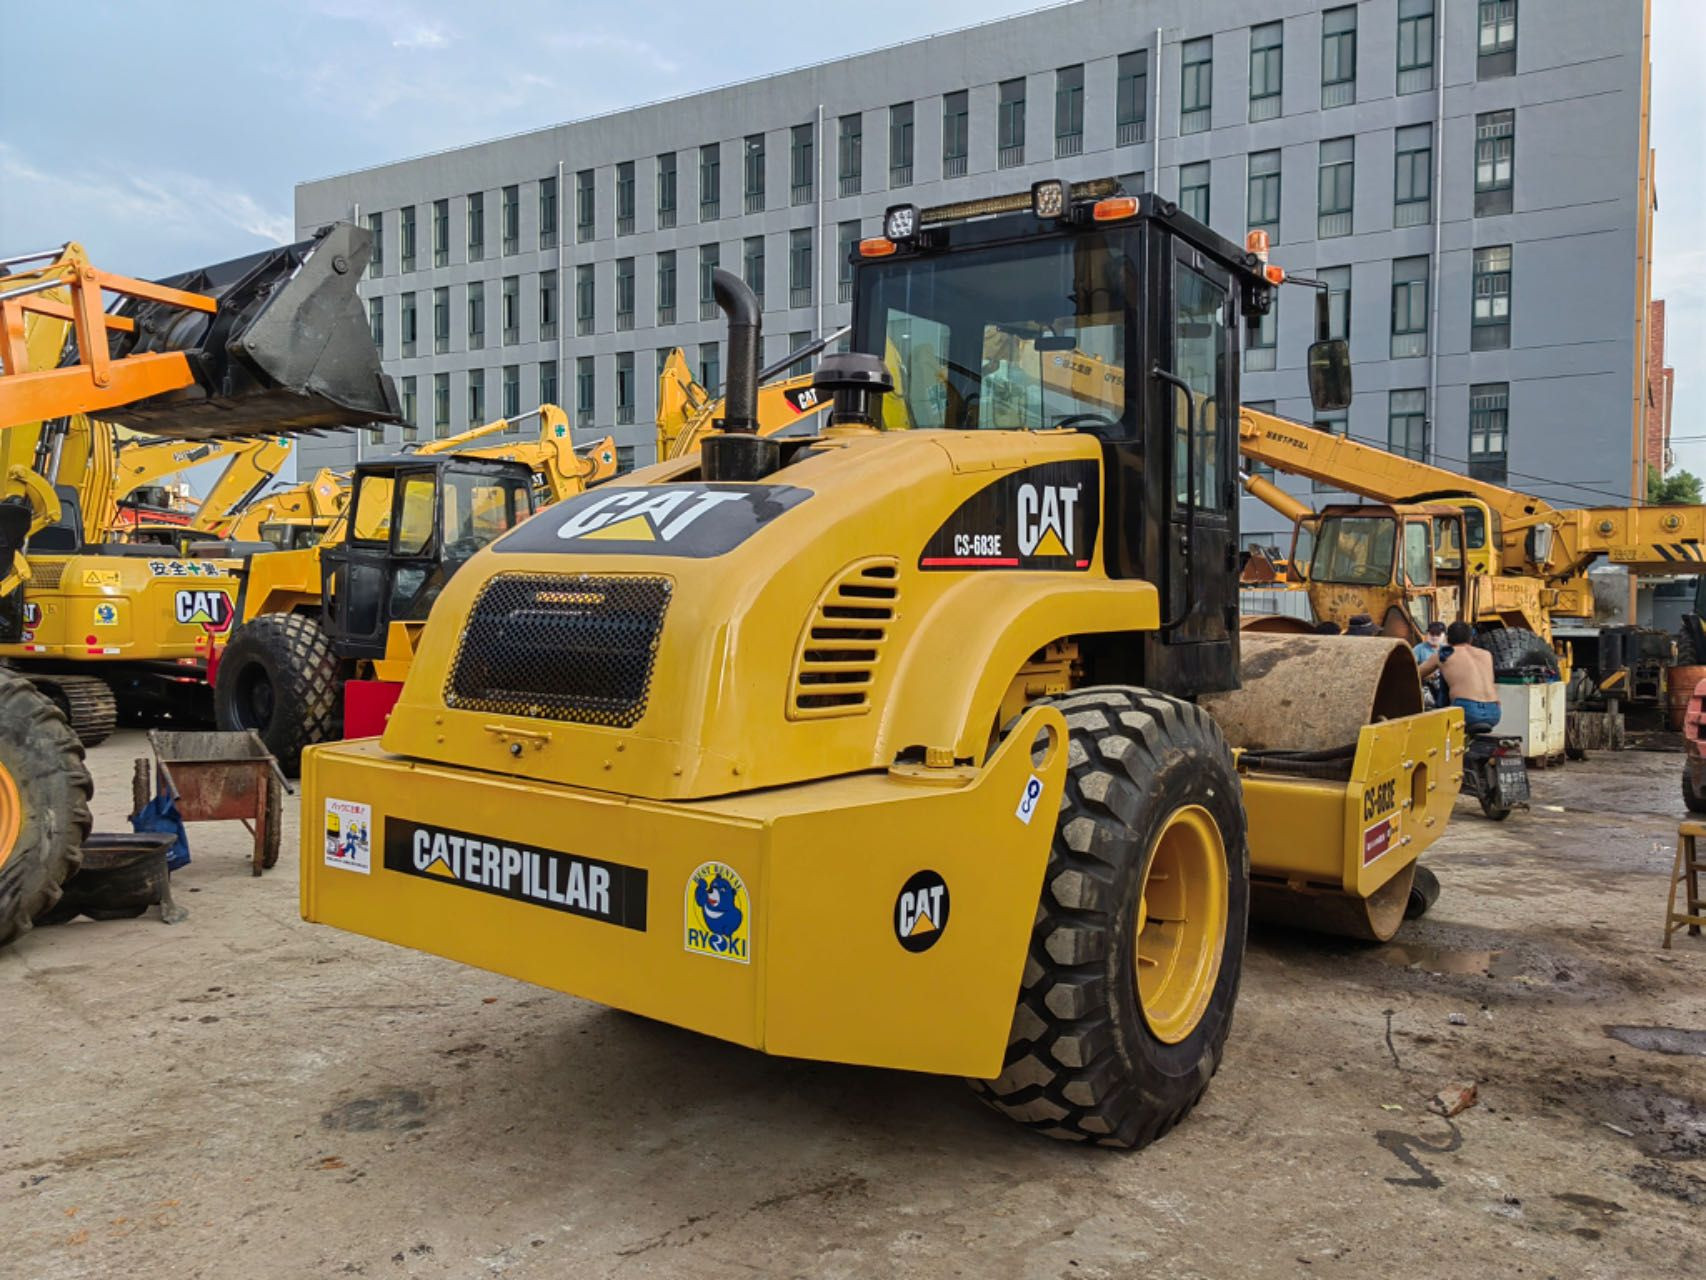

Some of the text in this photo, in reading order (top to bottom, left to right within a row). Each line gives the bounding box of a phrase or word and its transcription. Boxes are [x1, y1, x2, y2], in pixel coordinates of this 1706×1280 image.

[797, 388, 818, 409] CAT
[557, 491, 750, 541] CAT
[1017, 483, 1079, 556] CAT
[954, 535, 1002, 557] CS-683E
[176, 590, 221, 622] CAT
[413, 828, 611, 915] CATERPILLAR
[899, 885, 944, 937] CAT
[688, 928, 746, 955] RYOKI
